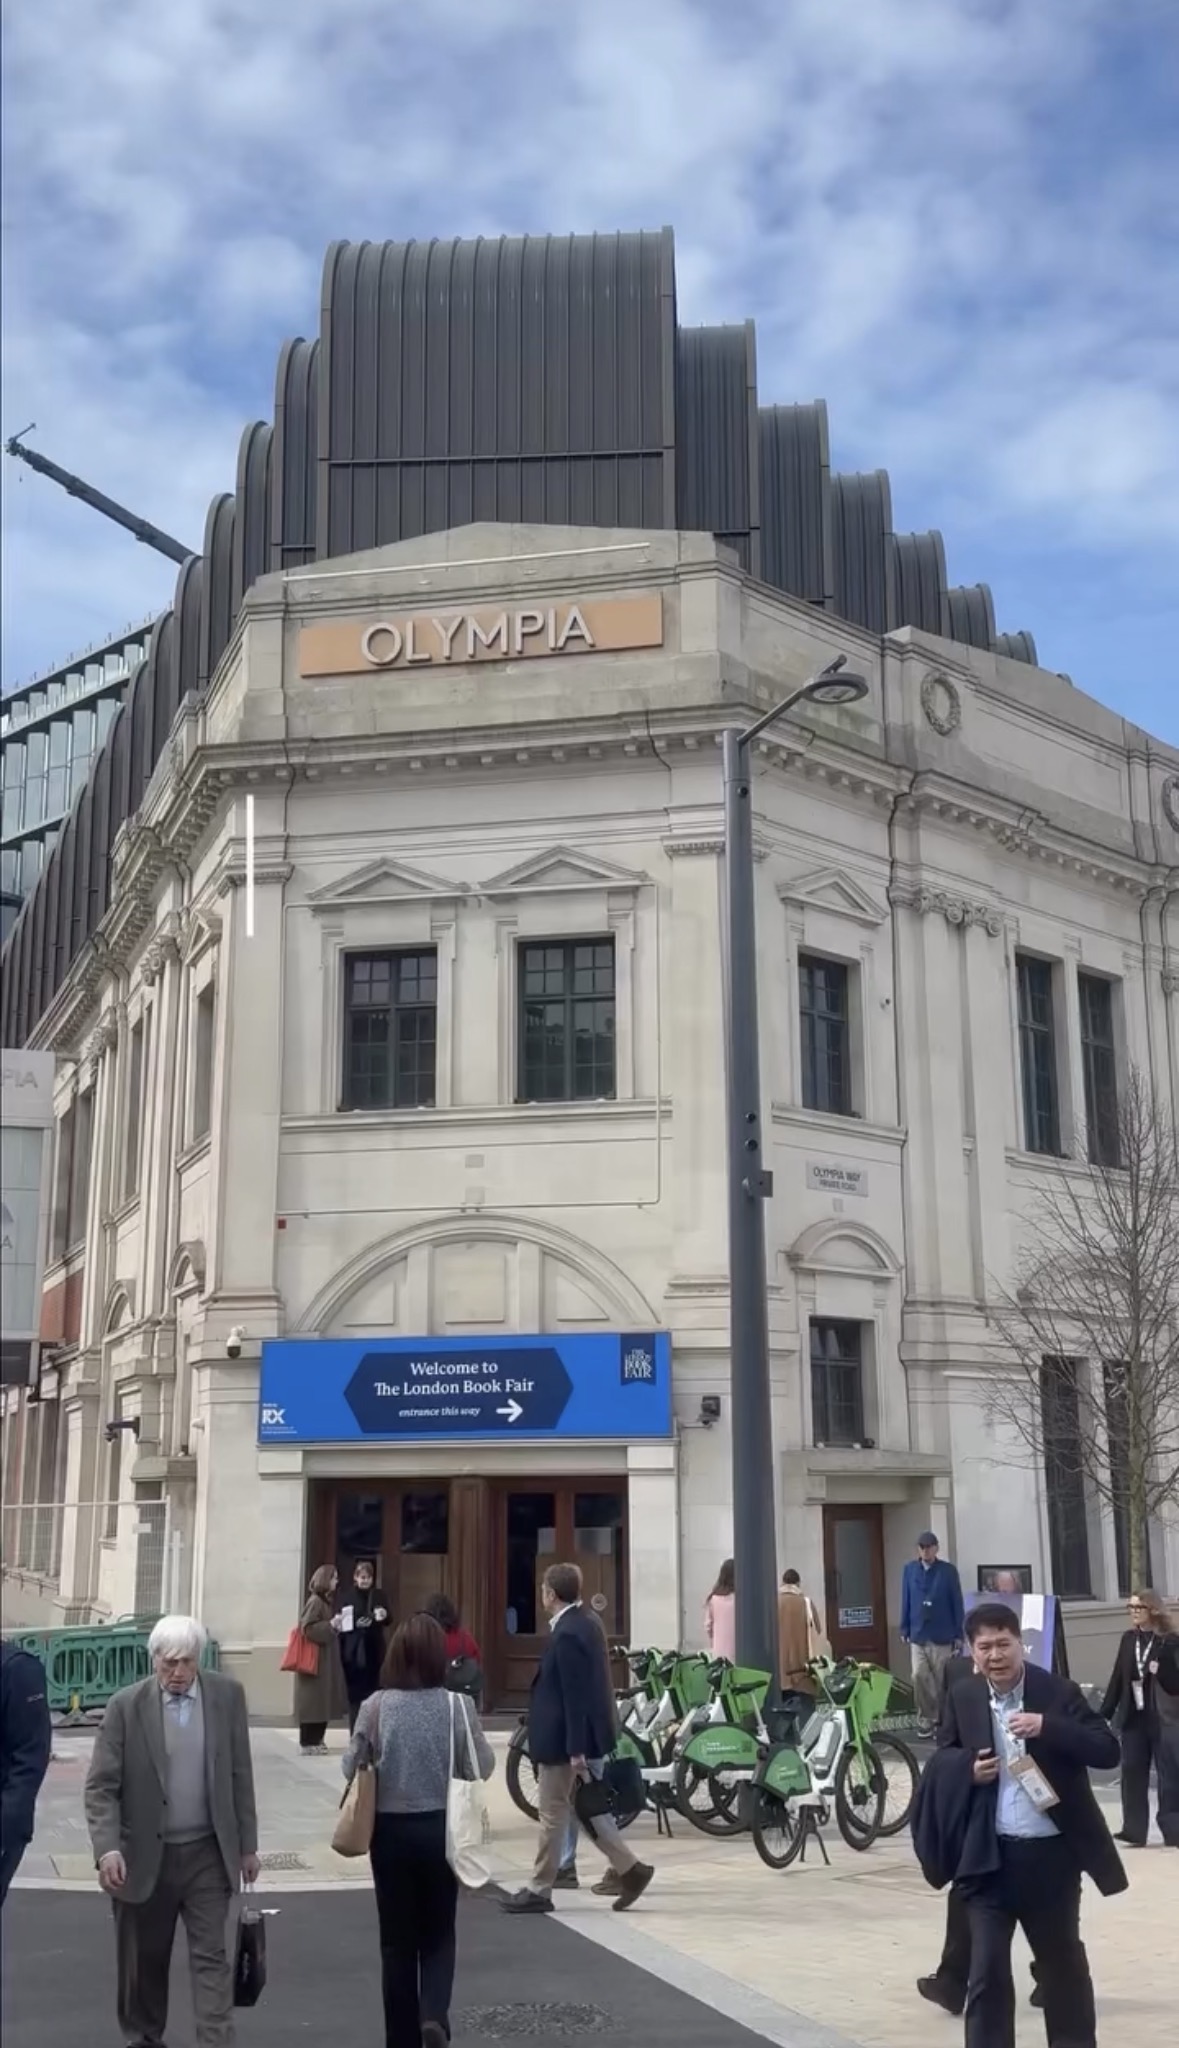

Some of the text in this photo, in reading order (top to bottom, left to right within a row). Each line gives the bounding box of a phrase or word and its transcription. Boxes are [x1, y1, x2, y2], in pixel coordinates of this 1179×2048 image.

[361, 604, 596, 666] OLYMPIA
[813, 1166, 844, 1180] OLYMPIA
[410, 1361, 499, 1376] Welcome to
[624, 1367, 652, 1379] FAIR
[374, 1378, 535, 1396] The London Book Fair
[262, 1408, 286, 1425] RX
[399, 1405, 481, 1418] entrance this way
